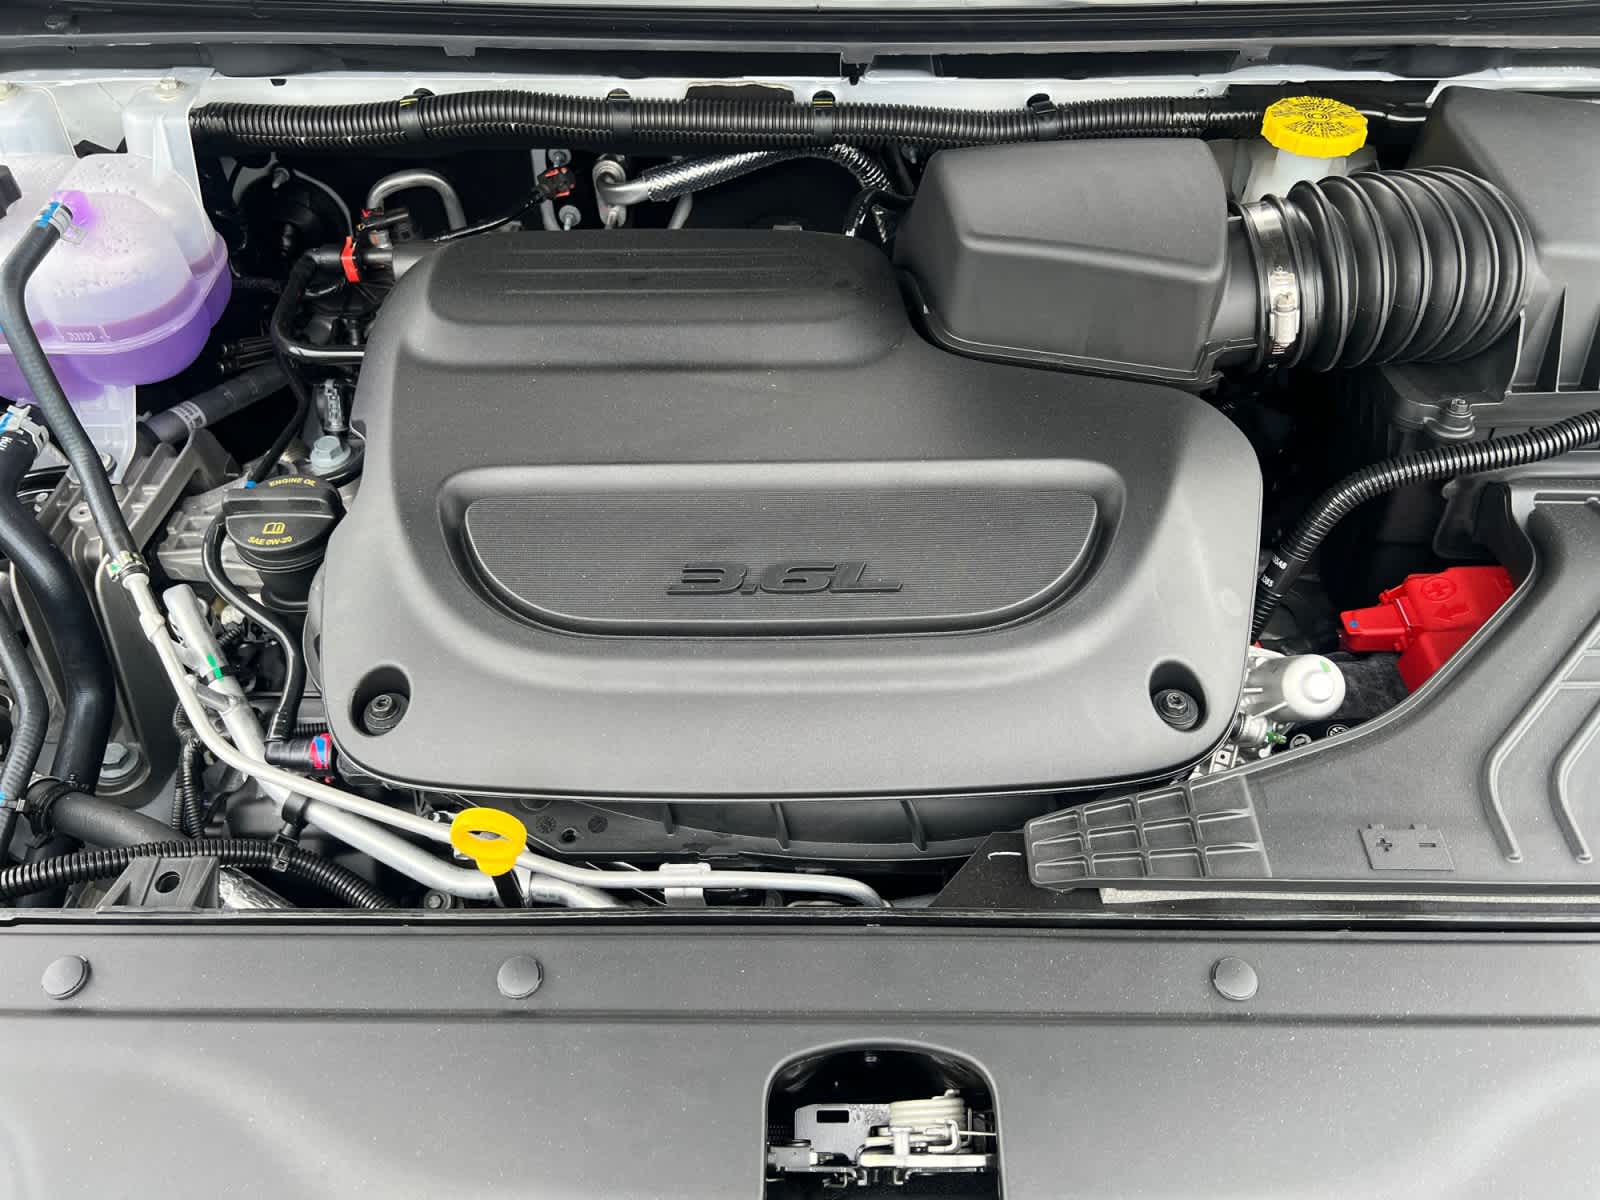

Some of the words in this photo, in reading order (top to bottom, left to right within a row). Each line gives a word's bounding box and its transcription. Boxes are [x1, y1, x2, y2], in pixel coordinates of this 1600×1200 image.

[269, 477, 303, 487] ENGINE
[248, 536, 264, 545] SAE
[266, 536, 293, 546] 0W-20
[666, 561, 903, 595] 3.6L
